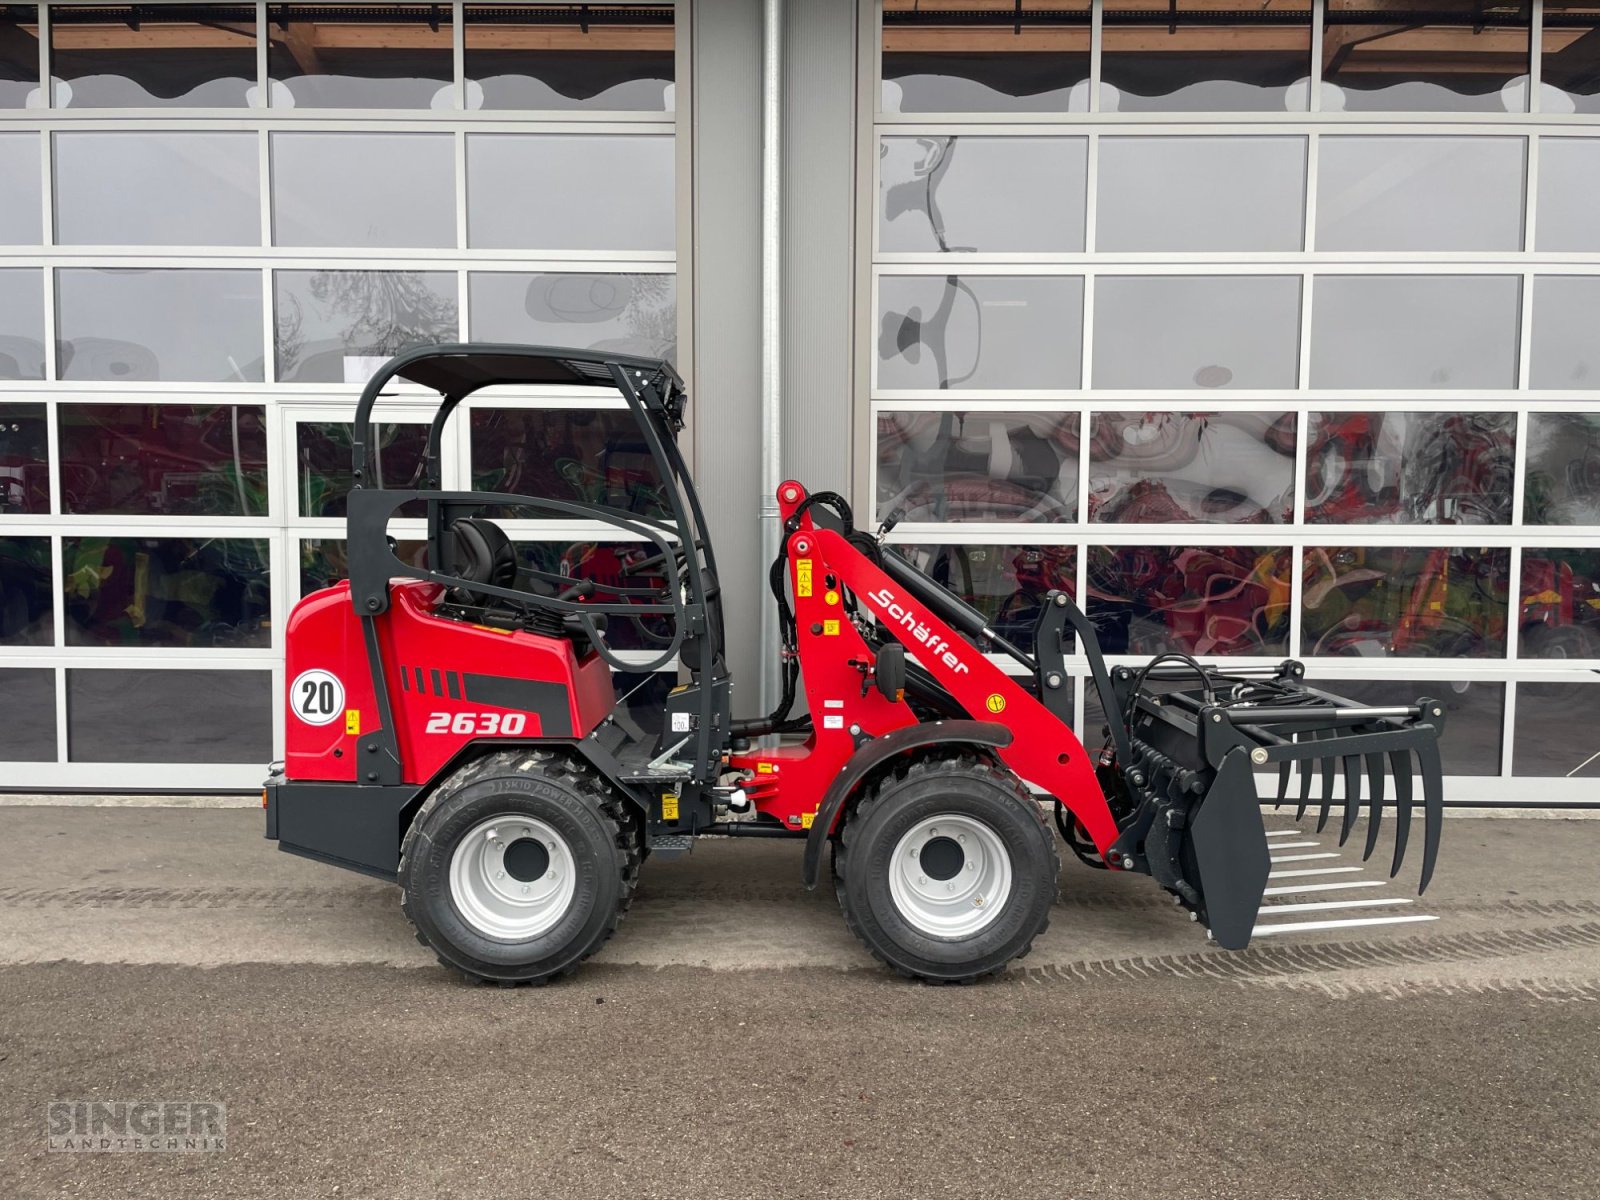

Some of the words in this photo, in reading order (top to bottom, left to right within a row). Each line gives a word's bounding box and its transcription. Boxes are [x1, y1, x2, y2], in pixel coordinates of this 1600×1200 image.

[867, 588, 969, 675] Schäffer
[302, 680, 334, 715] 20
[425, 711, 527, 735] 2630
